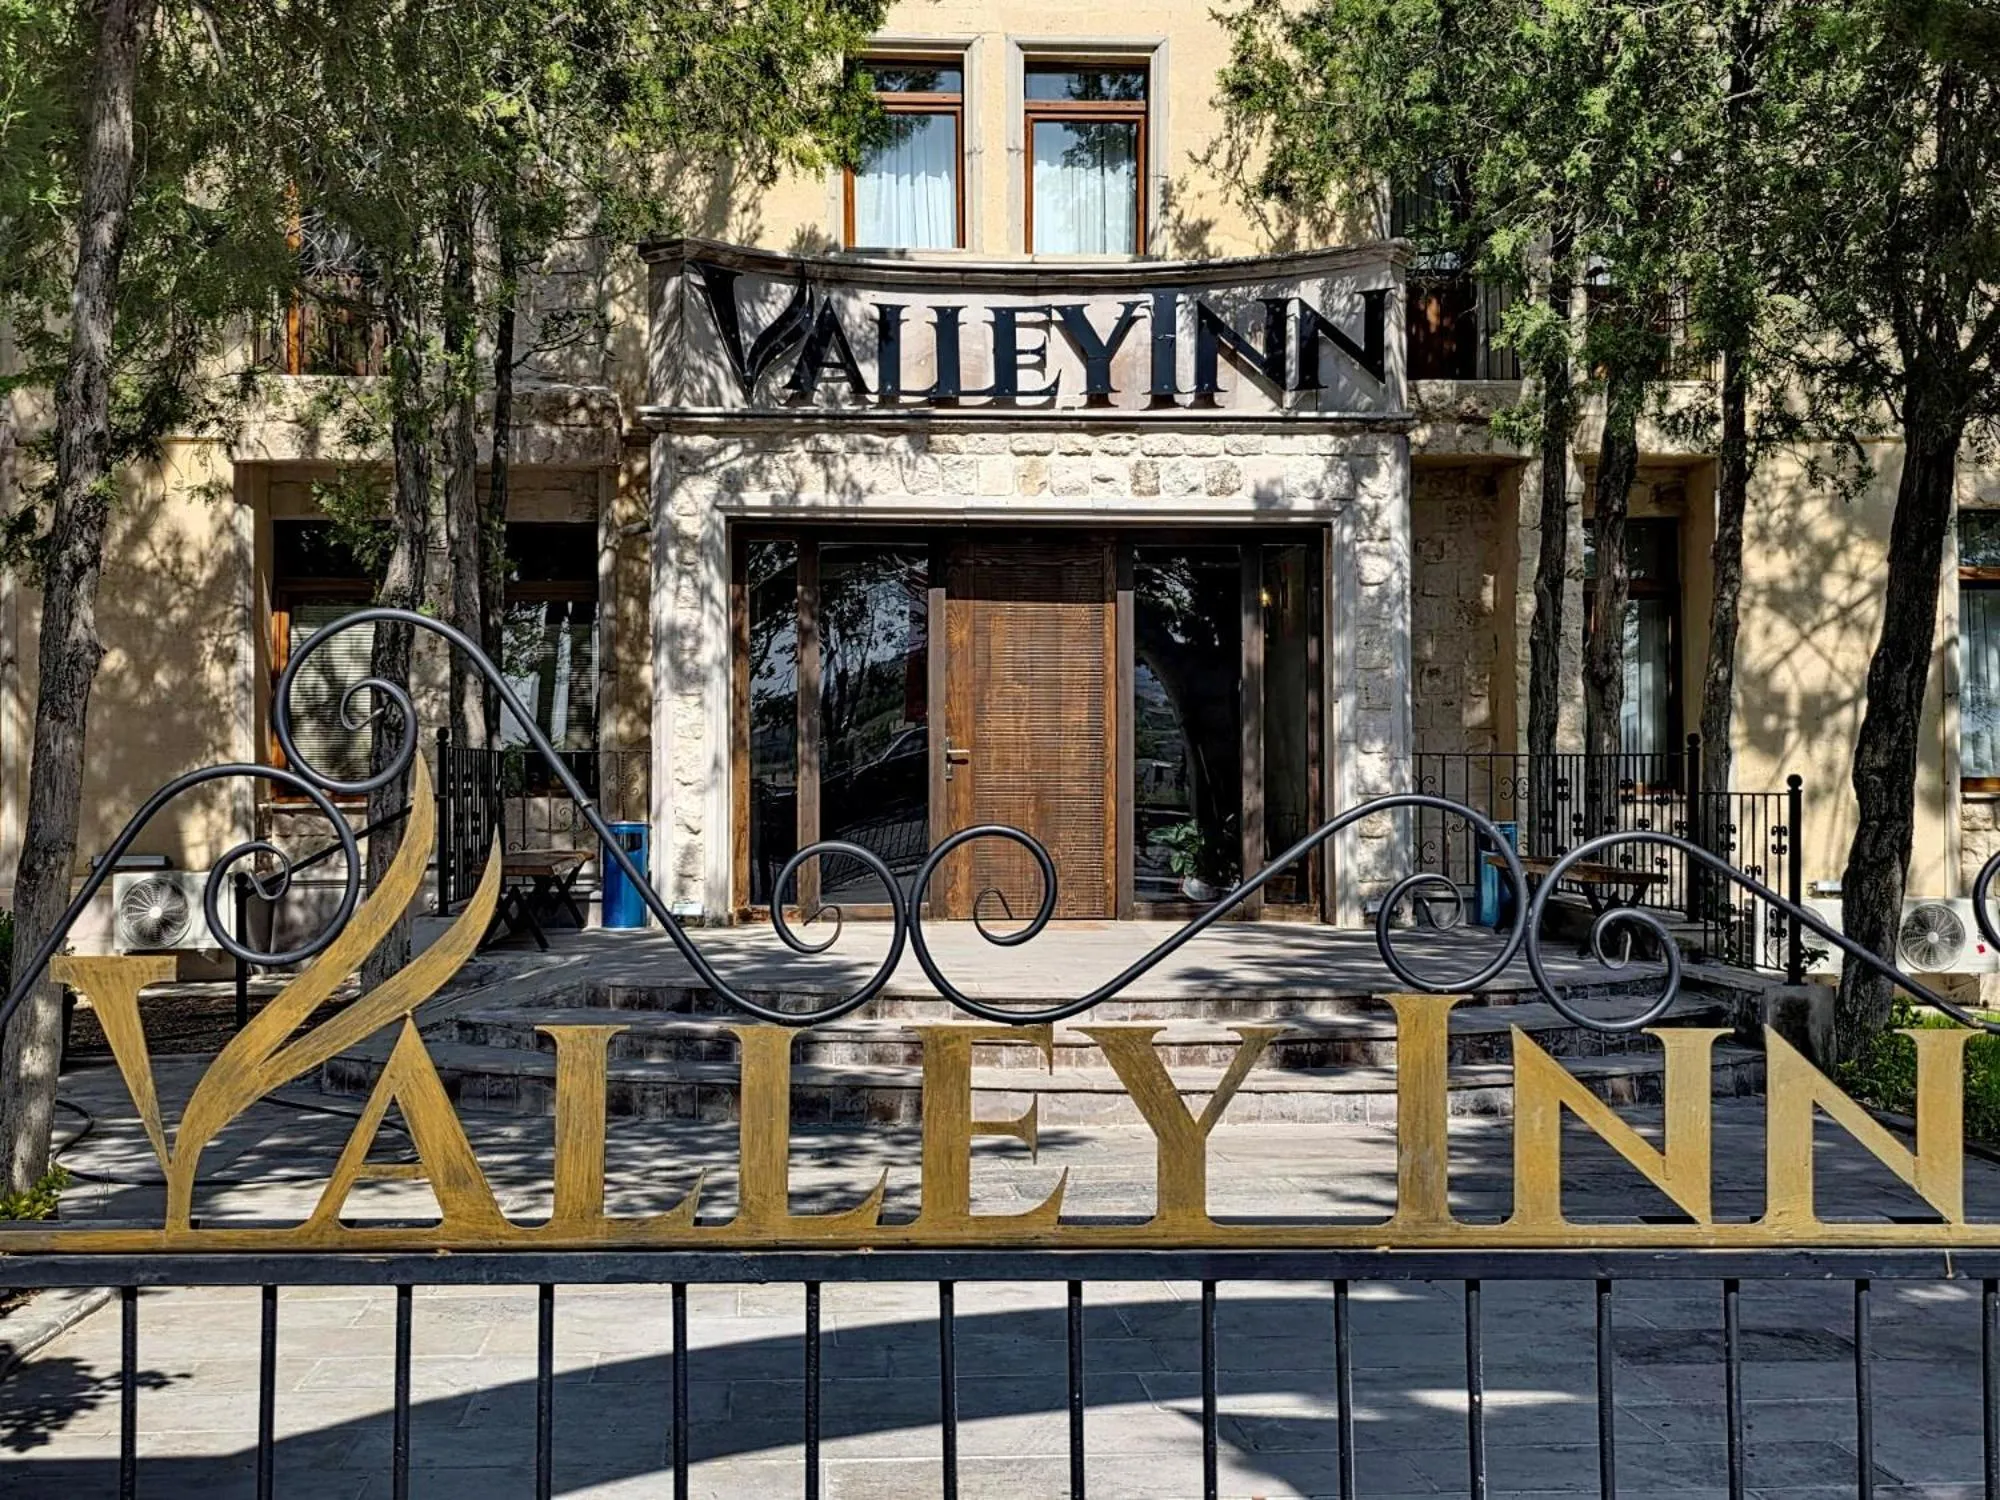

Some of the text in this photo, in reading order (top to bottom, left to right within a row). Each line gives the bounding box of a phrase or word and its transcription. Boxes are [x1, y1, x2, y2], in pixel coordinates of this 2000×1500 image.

[686, 260, 1396, 396] VALLEY INN
[50, 748, 1986, 1228] VALLEY INN
